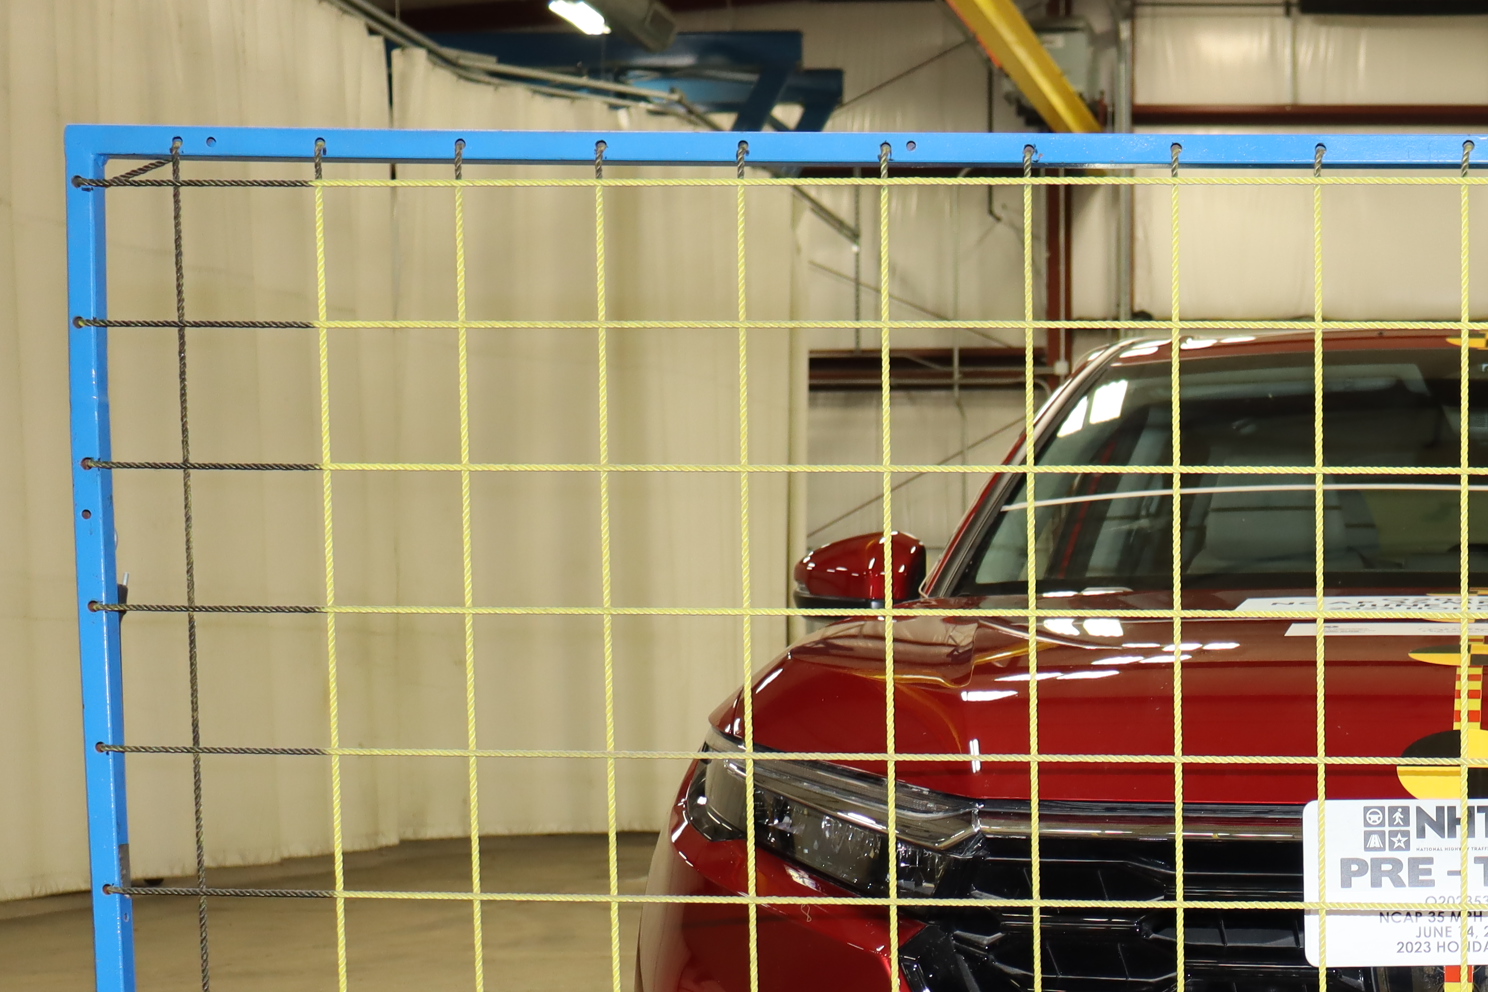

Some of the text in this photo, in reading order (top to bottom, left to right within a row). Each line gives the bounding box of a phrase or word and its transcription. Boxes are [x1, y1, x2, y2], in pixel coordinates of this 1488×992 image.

[1379, 911, 1423, 924] NCAP
[1428, 910, 1446, 923] 35
[1450, 910, 1483, 923] MPH
[1415, 925, 1453, 939] JUNE
[1458, 925, 1479, 939] 4,
[1396, 941, 1432, 954] 2023
